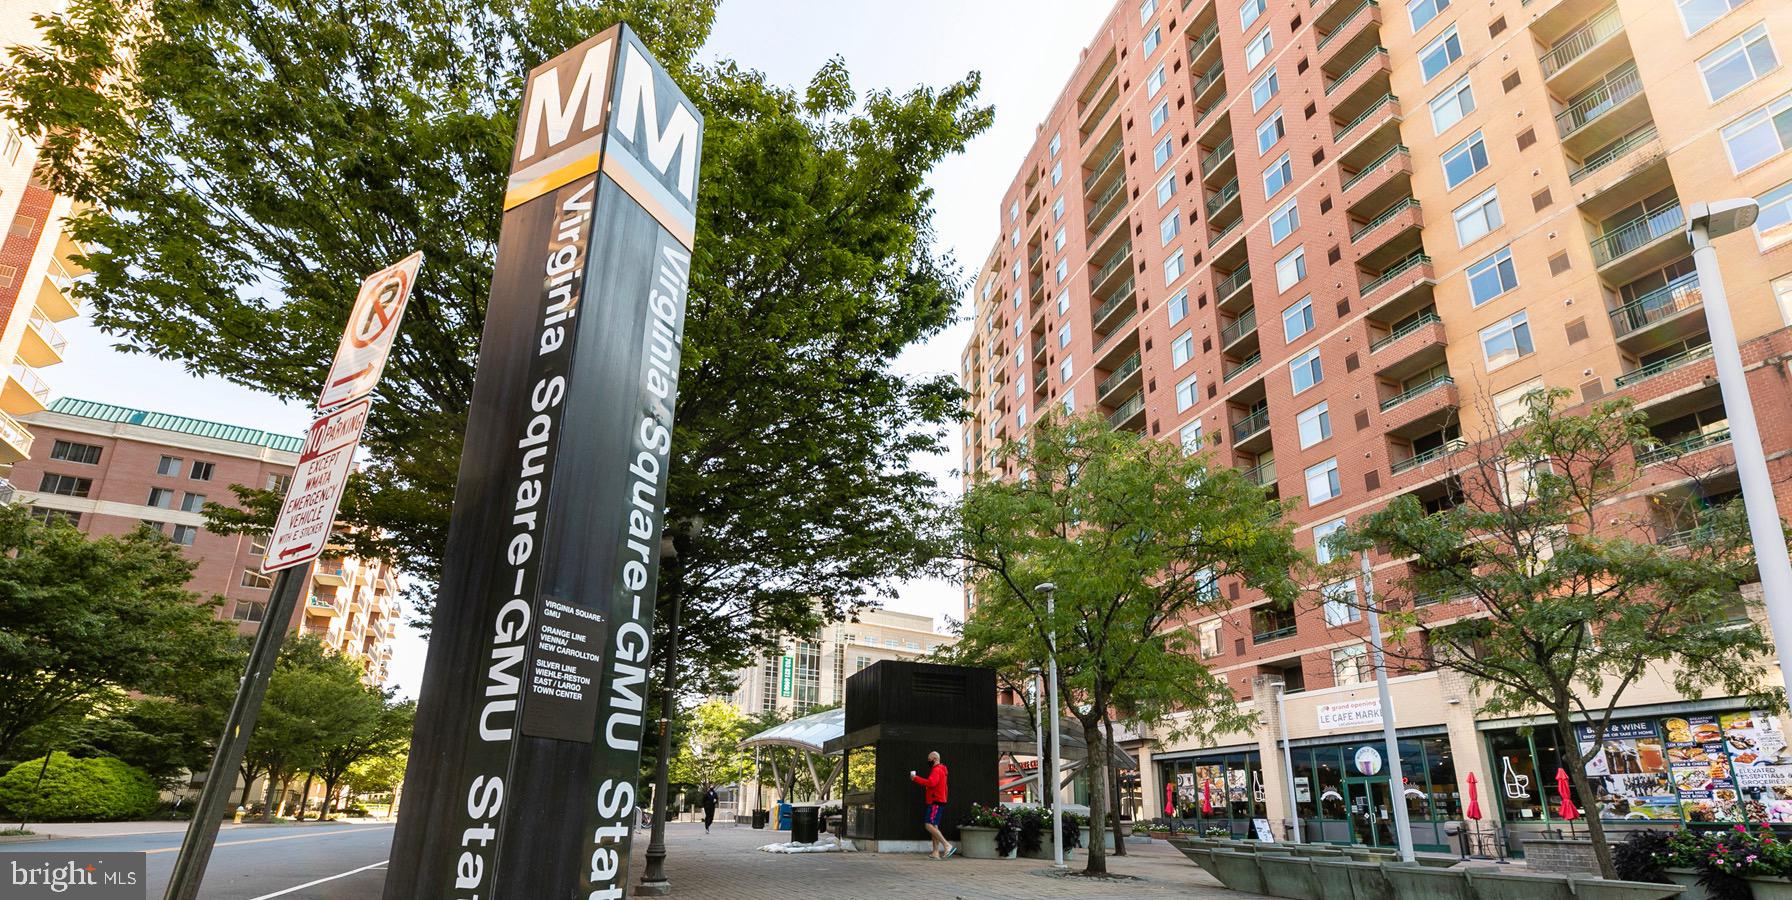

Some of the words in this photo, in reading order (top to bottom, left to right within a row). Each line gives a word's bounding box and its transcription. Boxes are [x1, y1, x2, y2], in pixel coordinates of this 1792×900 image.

[519, 38, 612, 161] M
[616, 41, 699, 201] M
[539, 180, 595, 356] Virginia
[646, 245, 690, 401] Virginia
[303, 425, 326, 456] NO
[323, 412, 364, 443] PARKING
[308, 451, 341, 475] EXCEPT
[305, 471, 331, 491] WMATA
[287, 484, 338, 513] EMERGENCY
[289, 505, 325, 529] VEHICLE
[278, 534, 291, 544] WITH
[299, 522, 323, 538] STICKER
[544, 608, 561, 618] GMU
[545, 600, 574, 614] VIRGINIA
[575, 609, 601, 622] SQUARE
[540, 633, 568, 646] VIENNA/
[541, 625, 570, 638] ORANGE
[571, 633, 586, 642] LINE
[539, 642, 556, 652] NEW
[556, 646, 600, 662] CARROLLTON
[535, 667, 590, 685] WIEHLE-RESTON
[536, 659, 560, 670] SILVER
[561, 664, 577, 674] LINE
[533, 685, 554, 695] TOWN
[555, 689, 582, 700] CENTER
[534, 676, 552, 686] EAST
[557, 681, 581, 691] LARGO
[1350, 701, 1377, 709] opening
[1320, 715, 1330, 724] LE
[1332, 712, 1352, 722] CAFE
[1621, 722, 1647, 731] WINE
[455, 775, 504, 900] Sta
